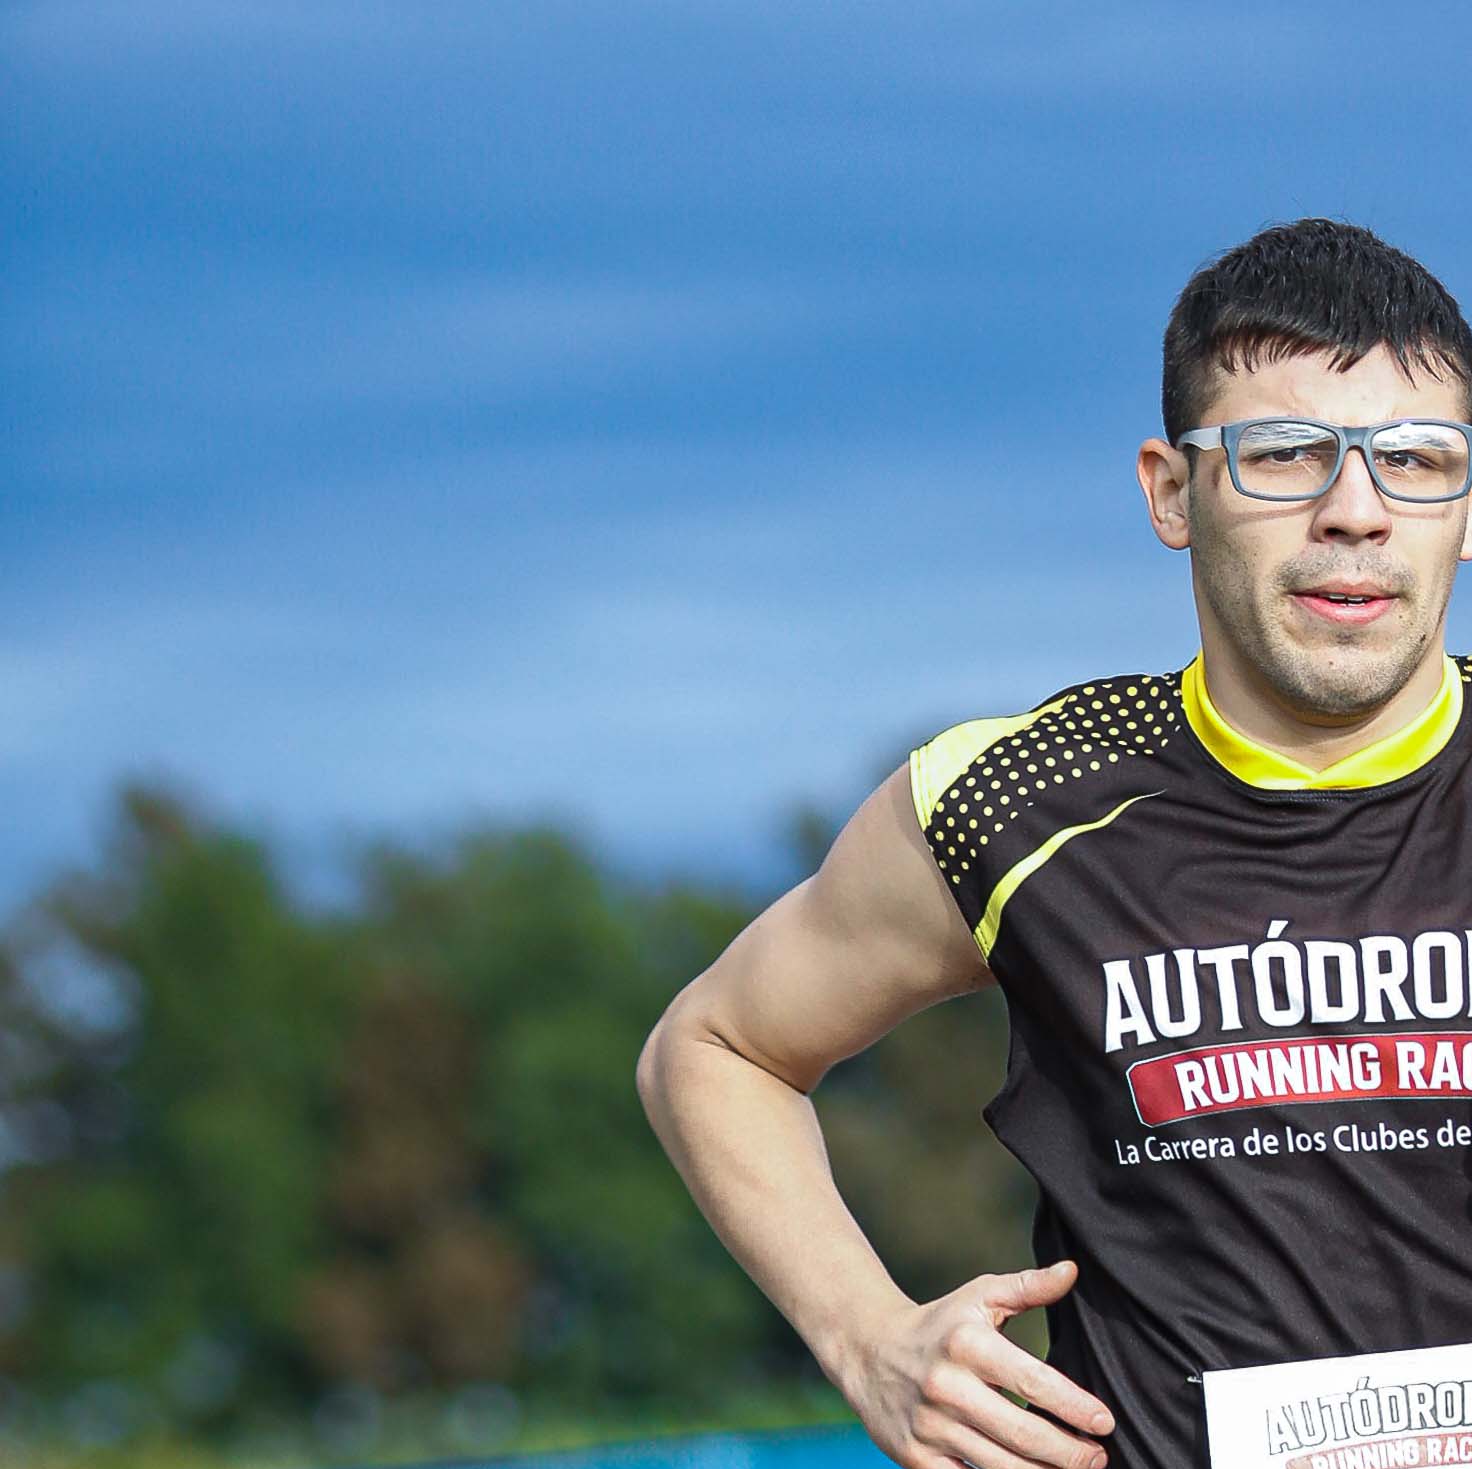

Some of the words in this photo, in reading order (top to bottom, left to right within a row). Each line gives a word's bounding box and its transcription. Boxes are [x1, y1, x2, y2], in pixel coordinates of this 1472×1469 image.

[1174, 1042, 1382, 1111] RUNNING
[1115, 1139, 1140, 1165] La
[1144, 1136, 1236, 1161] Carrera
[1243, 1128, 1279, 1155] de
[1286, 1126, 1327, 1153] los
[1333, 1122, 1430, 1152] Clubes
